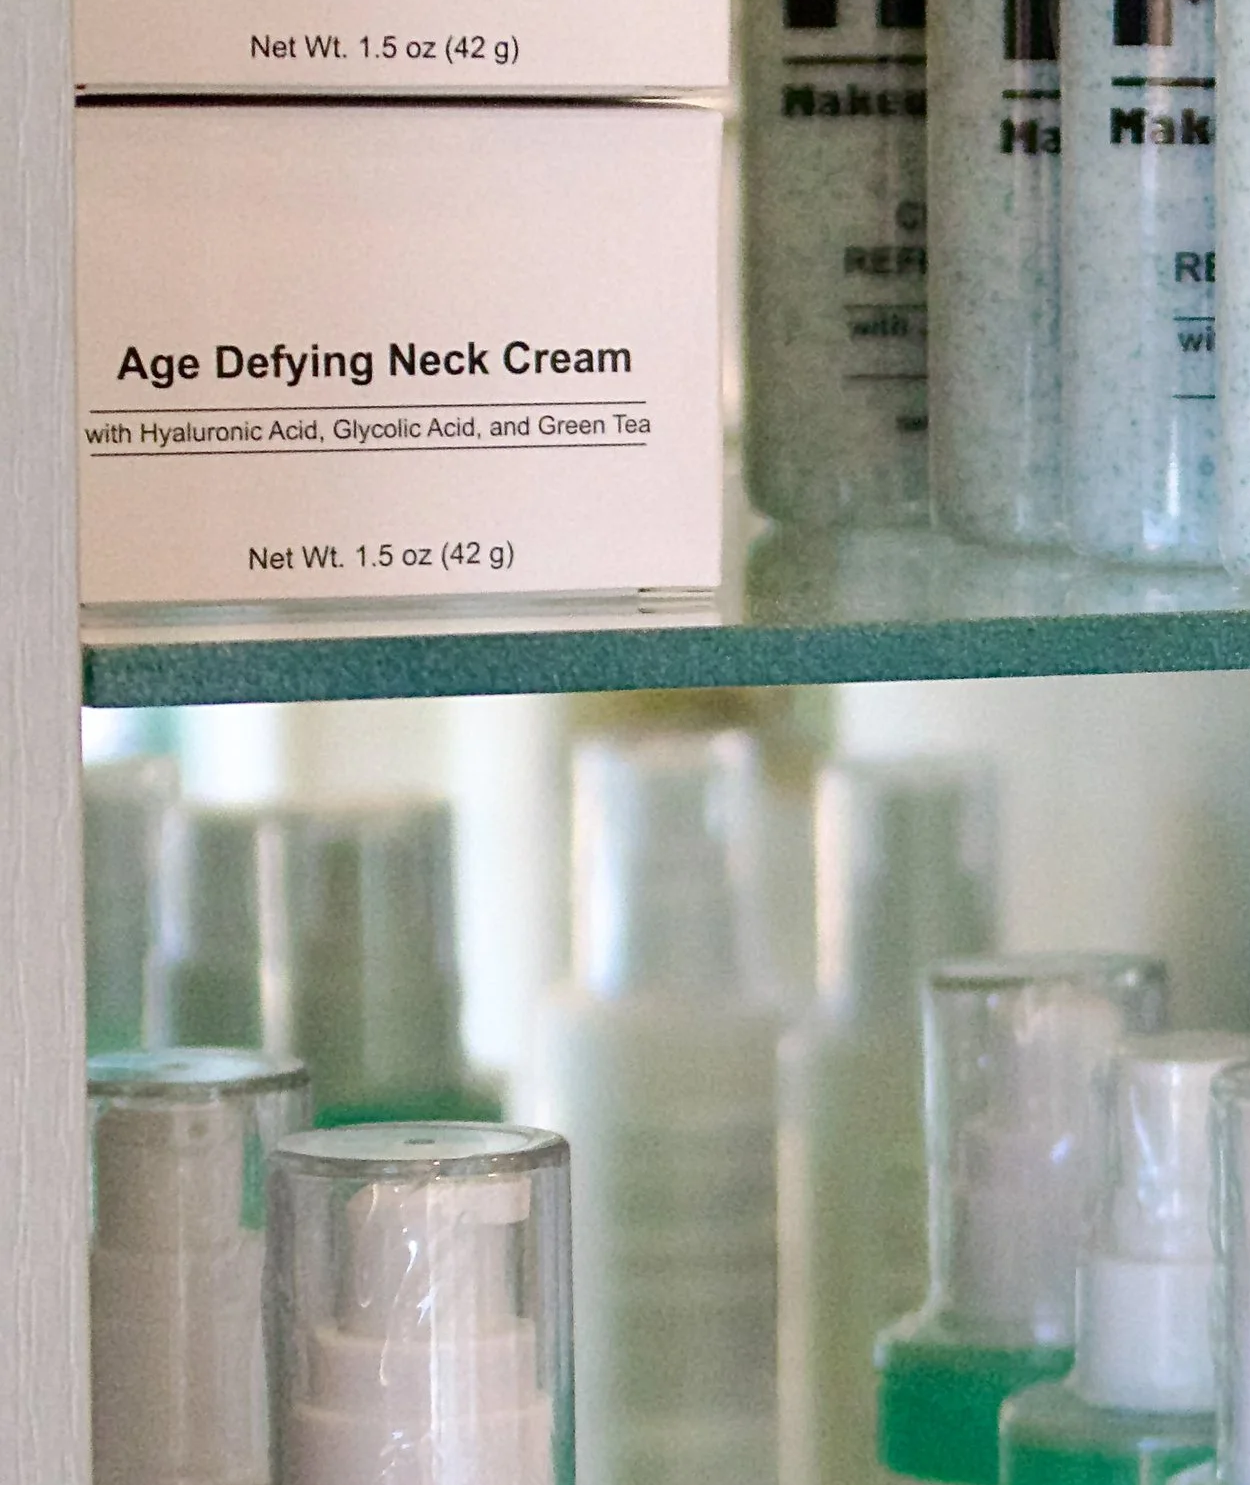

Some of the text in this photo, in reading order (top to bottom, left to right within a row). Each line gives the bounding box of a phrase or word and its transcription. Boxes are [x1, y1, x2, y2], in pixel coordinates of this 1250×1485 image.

[250, 34, 520, 66] Net Wt. 1.5 oz (42 g)
[116, 340, 632, 390] Age Defying Neck Cream
[84, 413, 652, 449] with Hyaluronic Acid, Glycolic Acid, and Green Tea
[248, 540, 515, 571] Net Wt. 1.5 oz (42 g)
